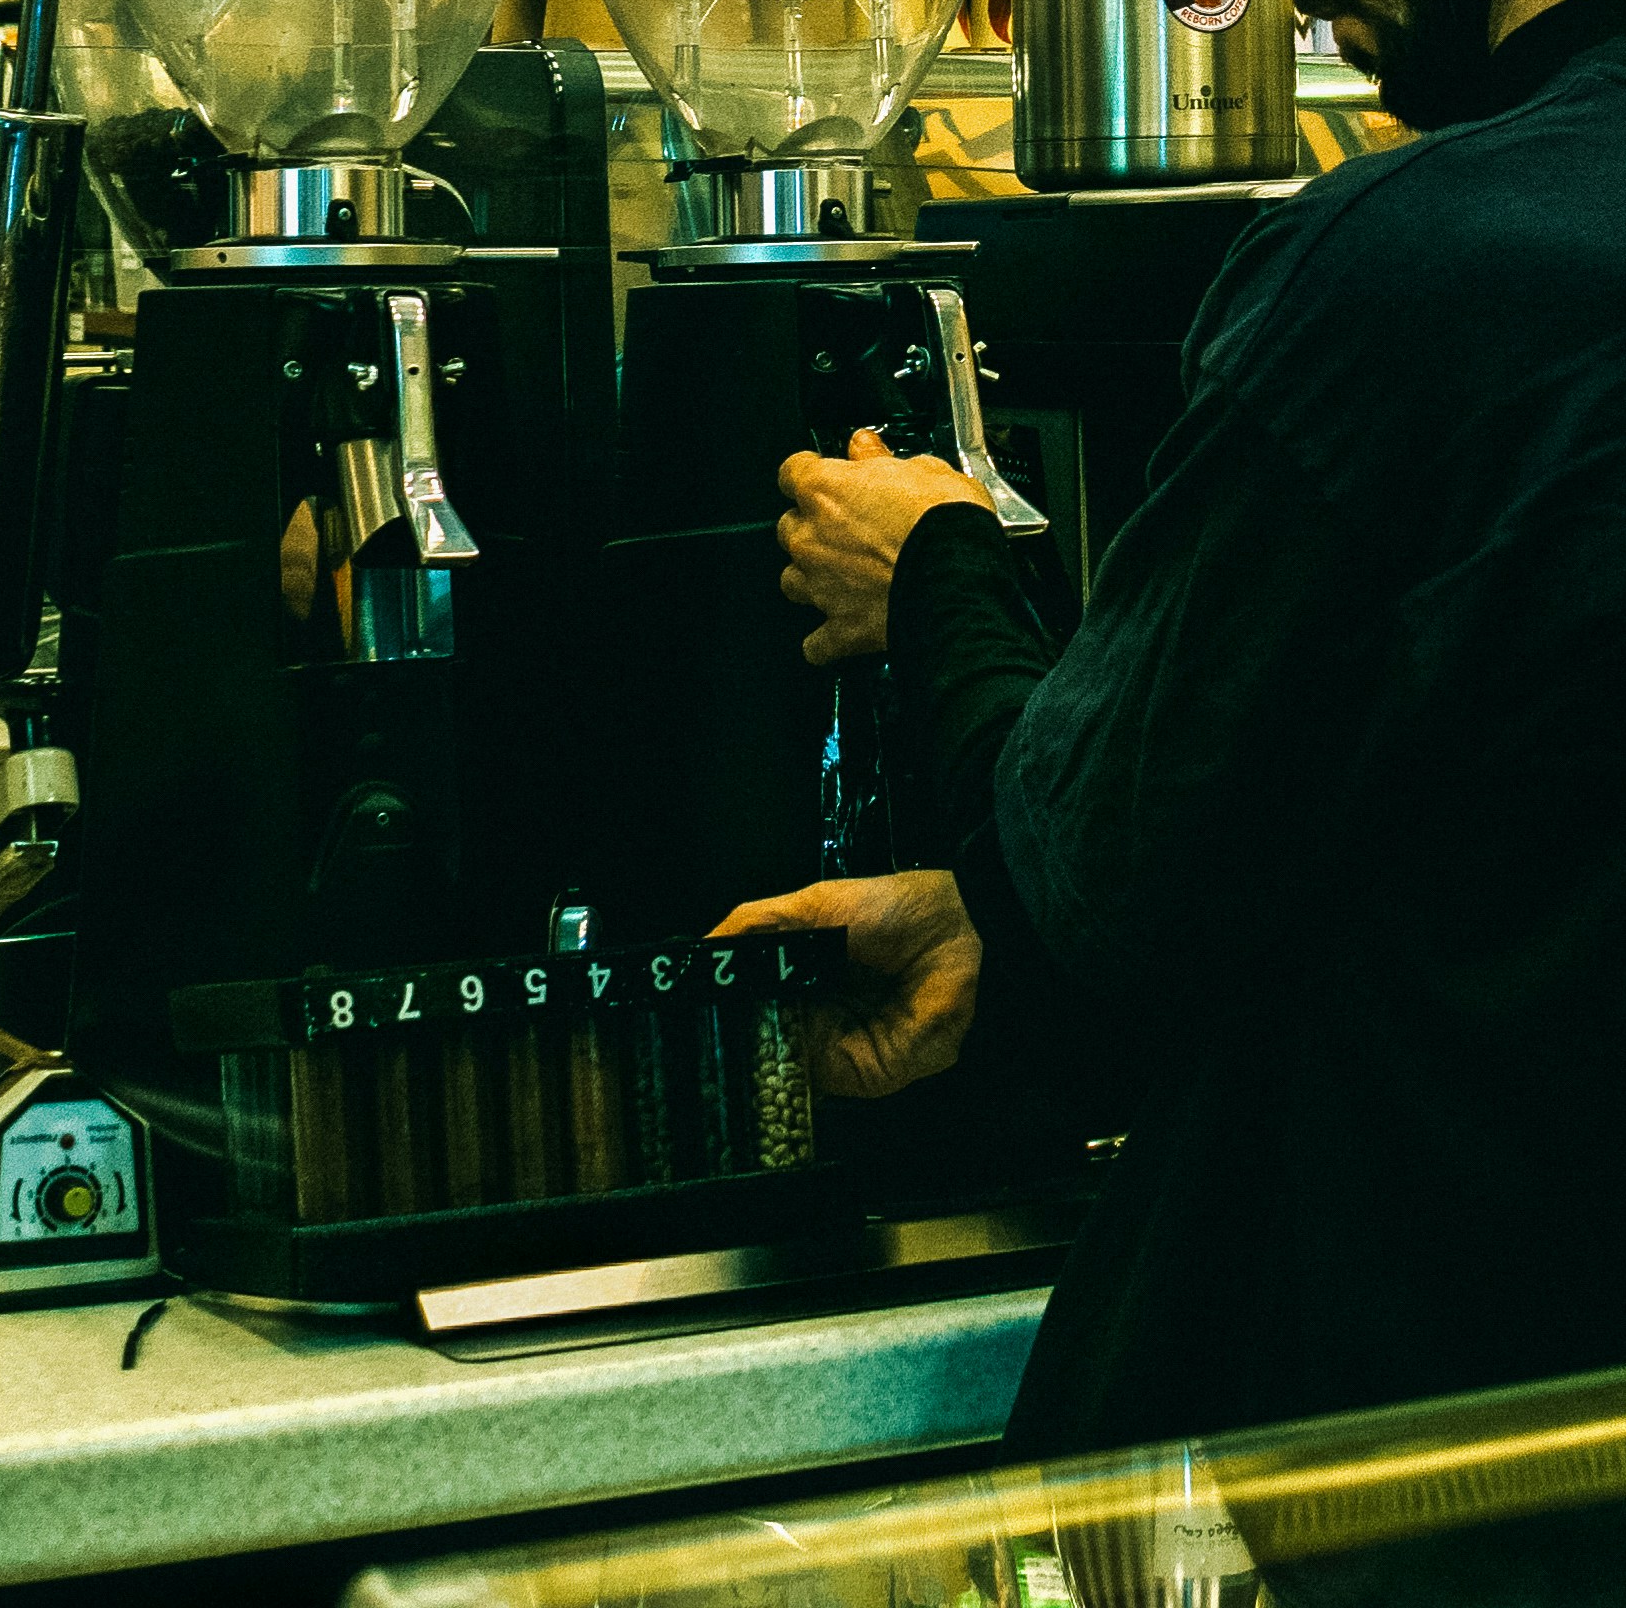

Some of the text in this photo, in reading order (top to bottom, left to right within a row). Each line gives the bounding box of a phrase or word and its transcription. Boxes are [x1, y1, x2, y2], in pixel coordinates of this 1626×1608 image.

[1180, 7, 1223, 27] REBORN
[1173, 84, 1243, 114] Unique
[330, 946, 794, 1028] 1 2 3 4 5 6 7 8
